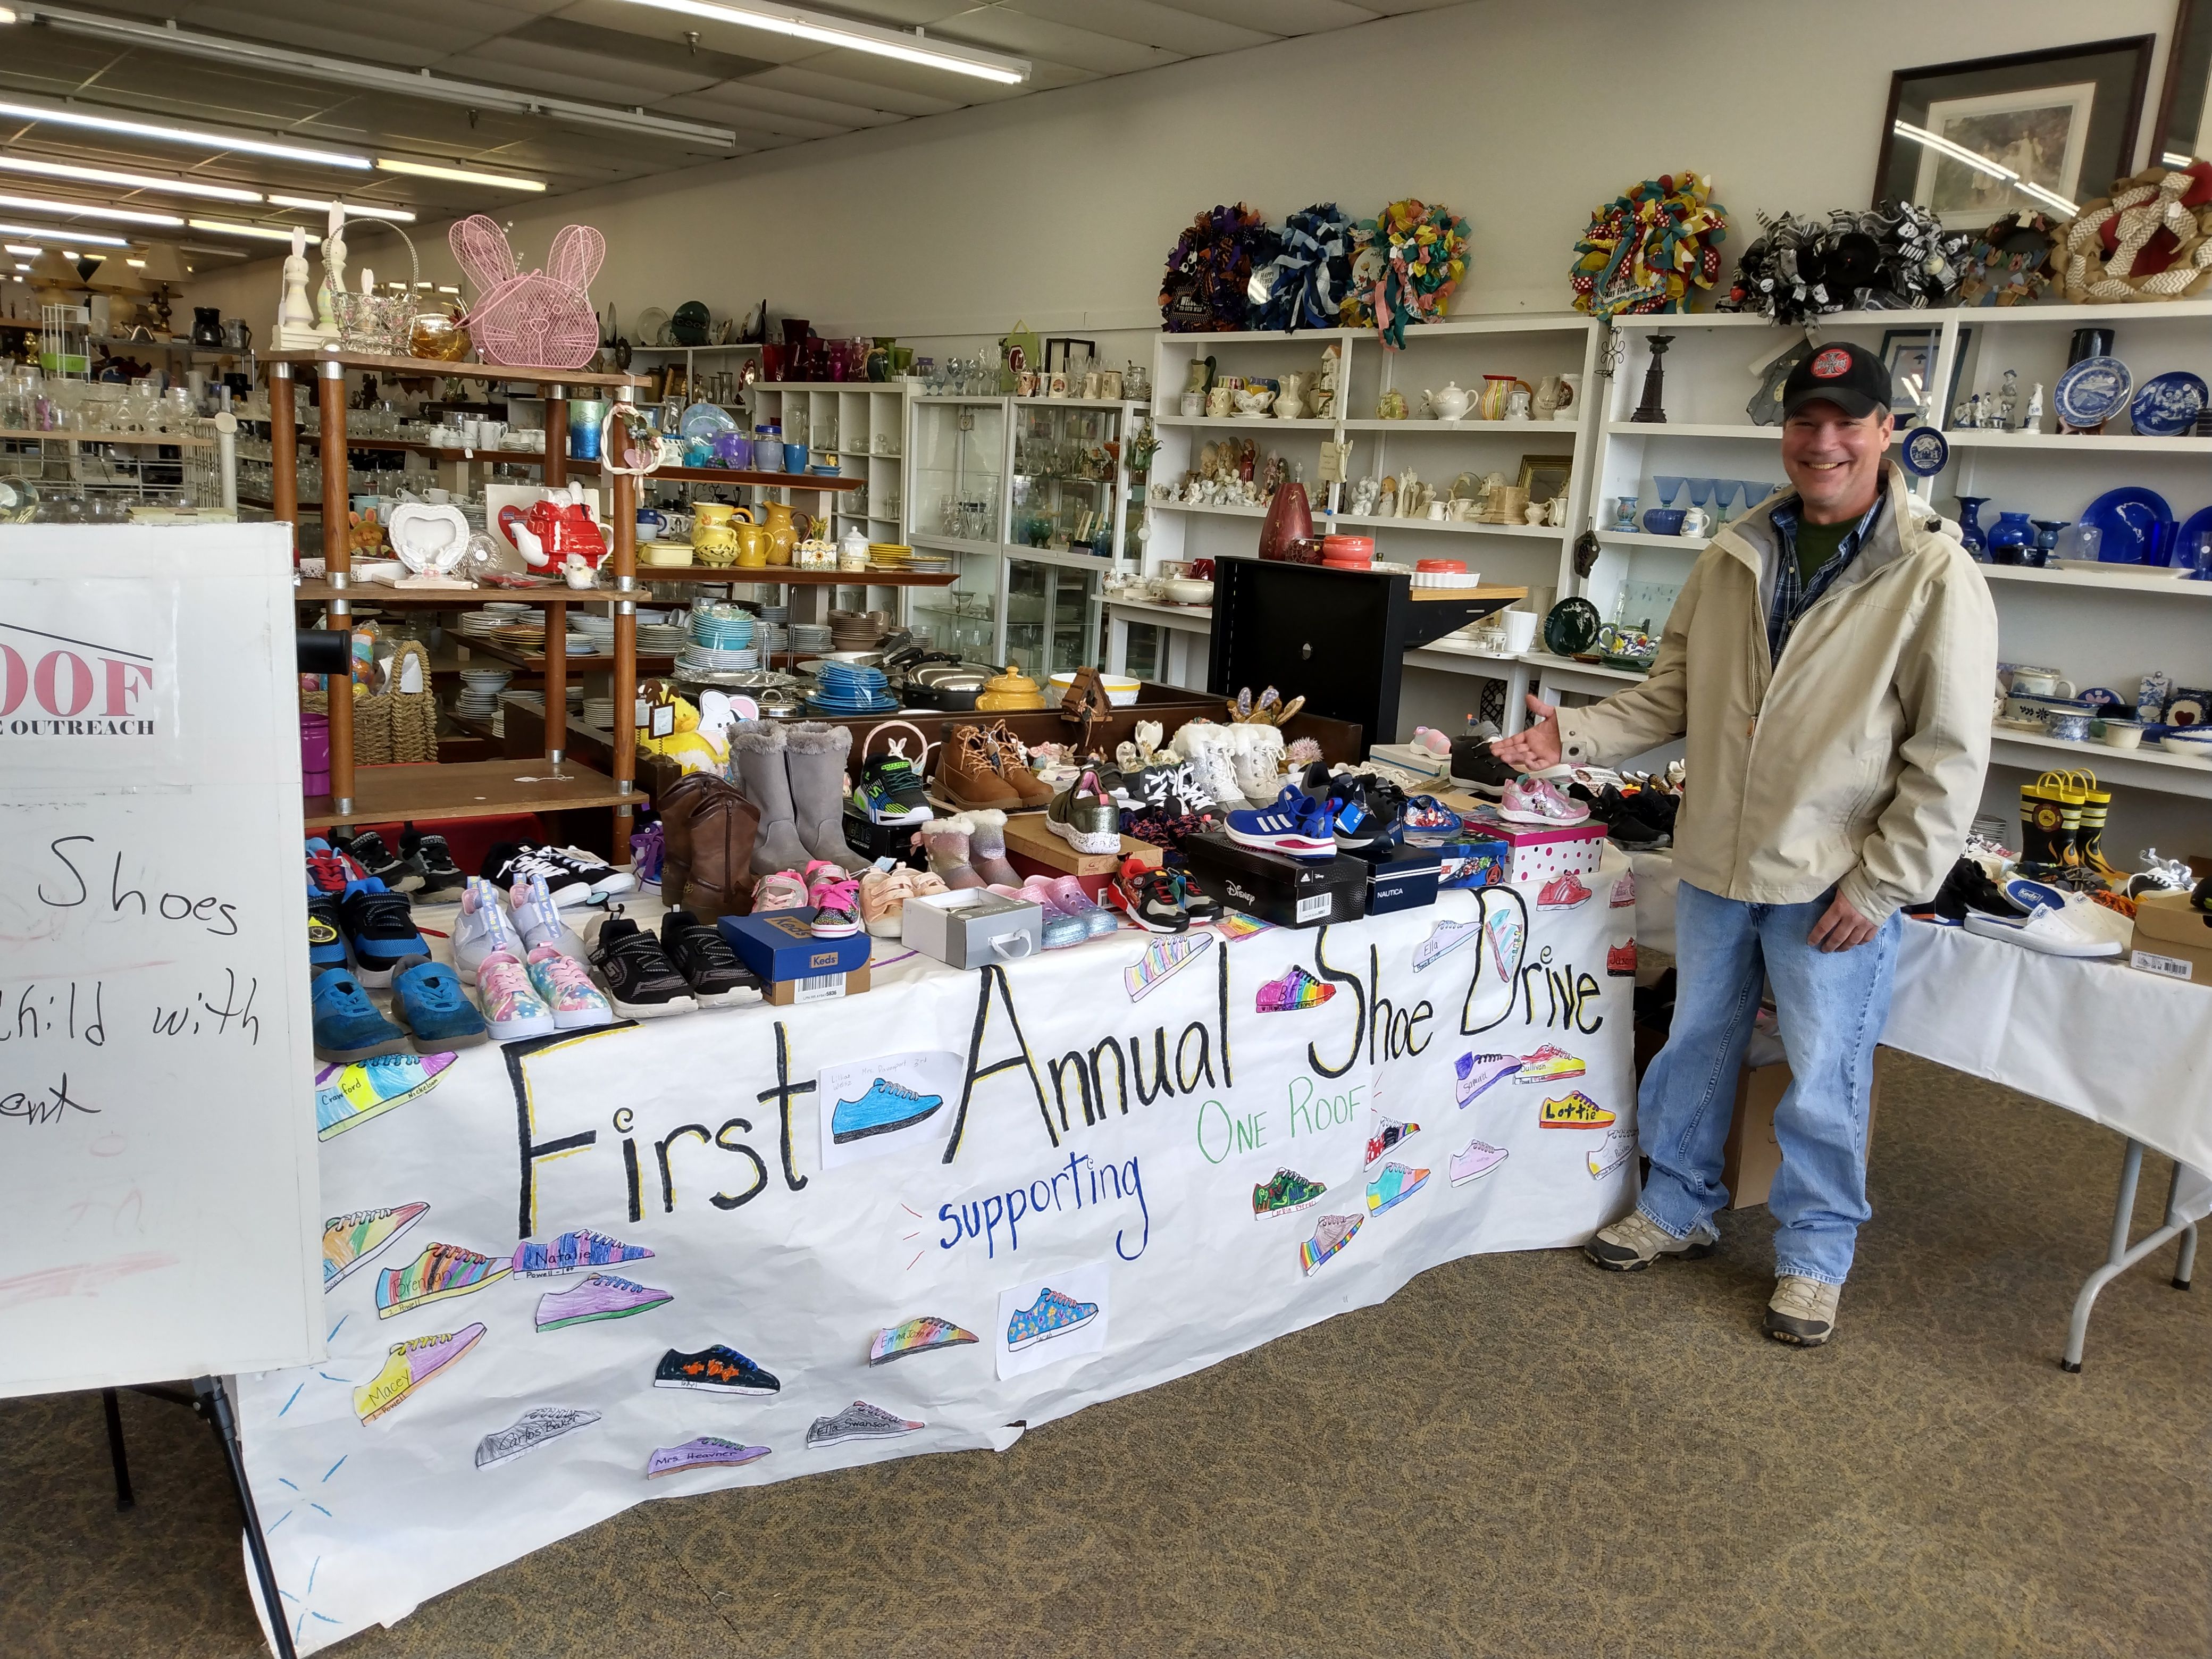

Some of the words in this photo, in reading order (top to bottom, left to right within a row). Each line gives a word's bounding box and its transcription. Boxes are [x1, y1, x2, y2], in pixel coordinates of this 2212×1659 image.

[1617, 284, 1639, 295] Flowers
[11, 720, 154, 735] OUTREACH
[38, 835, 238, 936] Shoes
[1377, 888, 1403, 899] NAUTICA
[2021, 889, 2039, 900] Keds
[1424, 941, 1438, 956] Ella
[814, 955, 837, 966] Keds
[0, 981, 105, 1046] hild
[153, 968, 258, 1045] with
[500, 1019, 817, 1239] First
[941, 941, 1234, 1164] Annual
[1308, 925, 1434, 1078] Shoe
[1460, 886, 1603, 1036] Drive
[878, 1060, 907, 1073] Davenport
[914, 1057, 927, 1068] 3rd
[322, 1079, 362, 1105] Crawford
[407, 1077, 438, 1100] Nickelson
[1288, 1076, 1366, 1141] ROOF
[1546, 1103, 1596, 1120] Lottie
[939, 1150, 1150, 1261] supporting
[535, 1247, 591, 1266] Natalie
[526, 1270, 552, 1279] Powell
[391, 1270, 452, 1297] Brenan
[1036, 1330, 1053, 1342] Farah
[368, 1369, 411, 1407] Macey
[499, 1427, 541, 1451] Carlos
[543, 1414, 580, 1432] Baker
[817, 1423, 838, 1435] Ella
[845, 1418, 890, 1429] Swanson
[655, 1455, 678, 1467] Mrs
[687, 1452, 738, 1460] Heavner
